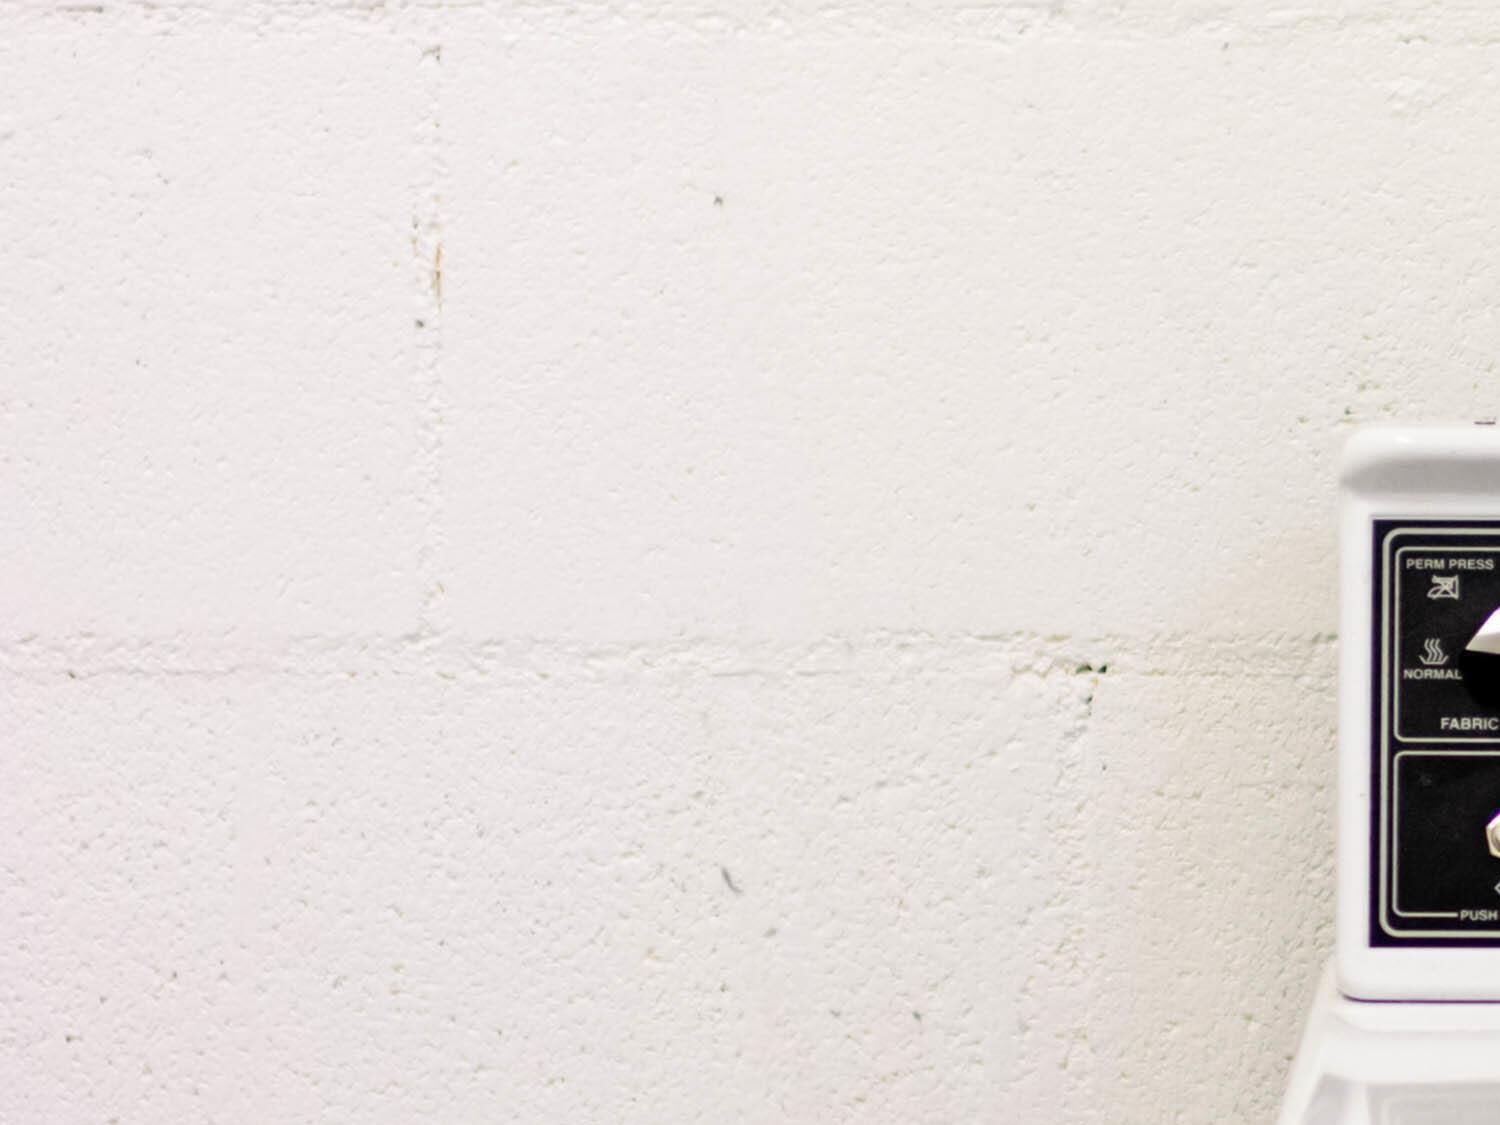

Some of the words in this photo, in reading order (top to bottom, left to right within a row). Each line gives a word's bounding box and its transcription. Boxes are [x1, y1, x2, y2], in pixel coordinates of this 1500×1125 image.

[1406, 558, 1446, 570] PERM
[1448, 559, 1495, 570] PRESS
[1403, 668, 1463, 680] NORMAL
[1440, 717, 1499, 731] FABRIC
[1460, 909, 1498, 921] PUSH
